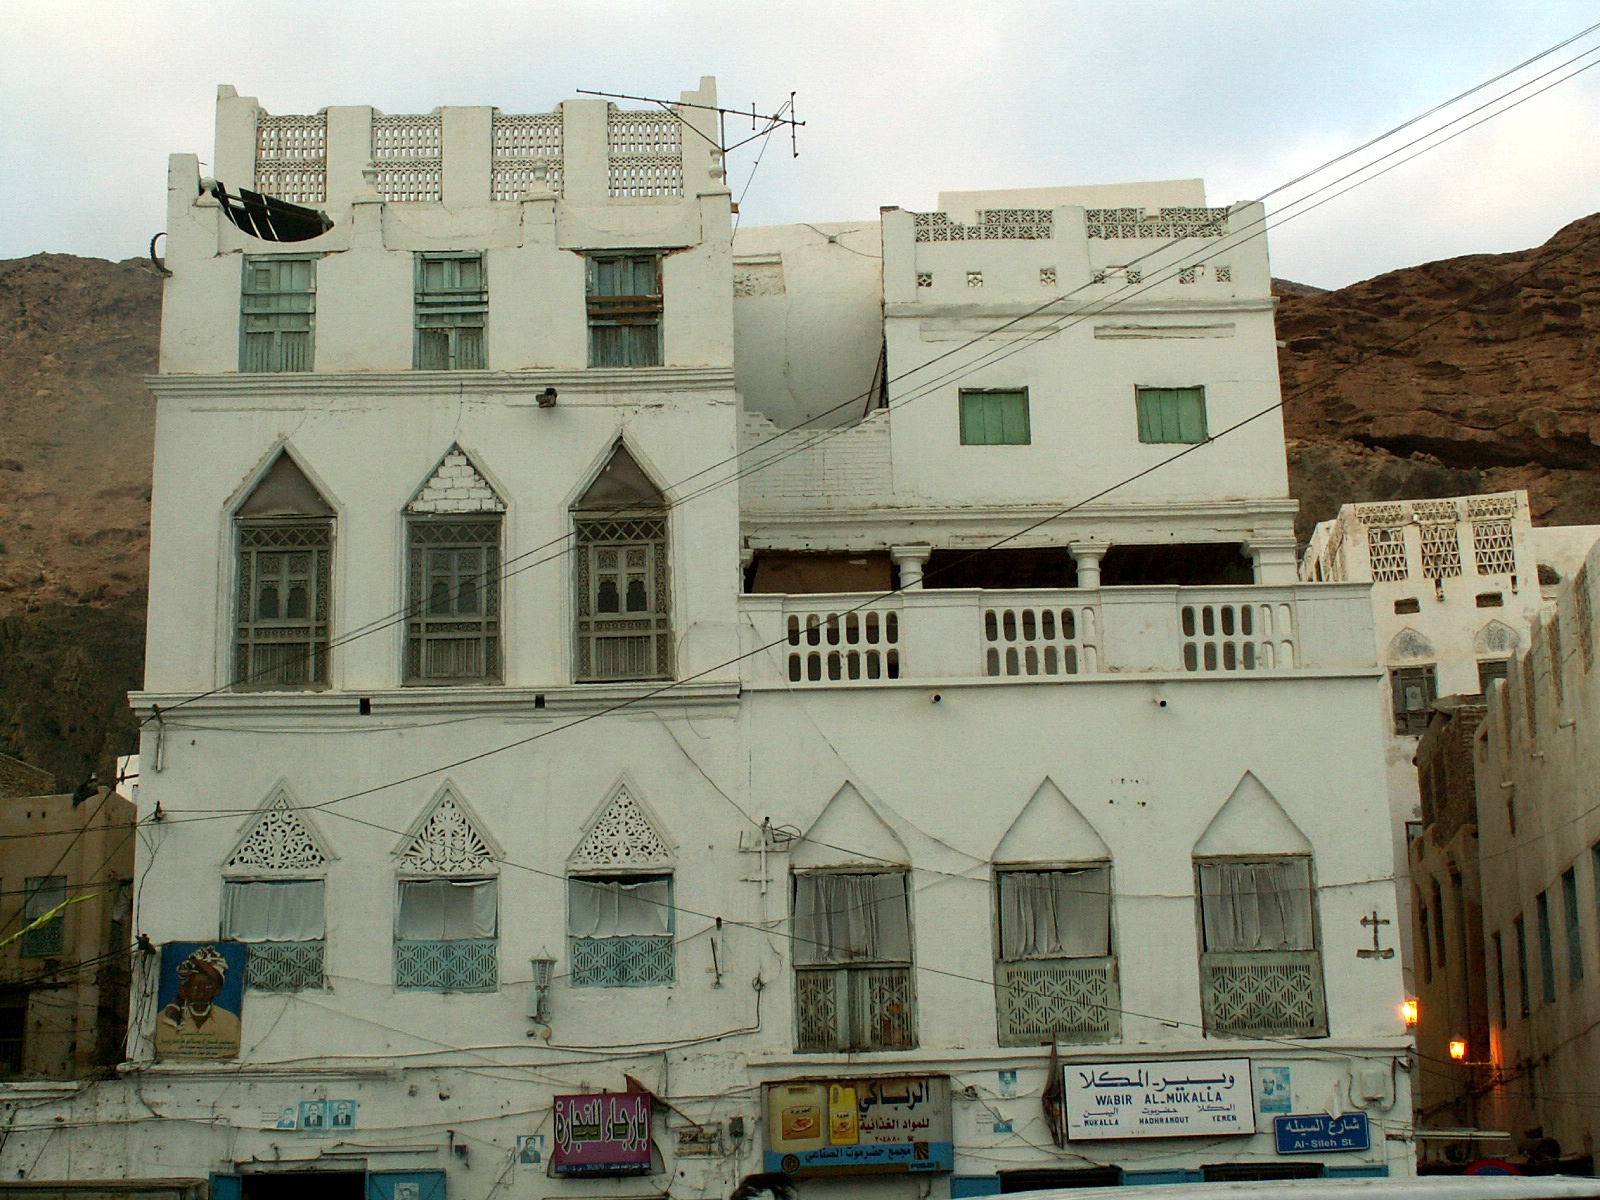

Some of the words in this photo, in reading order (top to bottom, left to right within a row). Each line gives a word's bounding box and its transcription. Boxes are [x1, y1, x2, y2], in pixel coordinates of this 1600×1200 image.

[1095, 1095, 1133, 1106] WABIR
[1083, 1106, 1119, 1118] اليمن
[1141, 1106, 1179, 1115] حضرموت
[1197, 1104, 1236, 1113] المكلا
[859, 1117, 899, 1134] الغذائية
[903, 1117, 930, 1132] للمواد
[1083, 1119, 1119, 1127] MUKALLA
[1139, 1116, 1190, 1125] HADHRAMOUT
[1212, 1114, 1238, 1123] YEMEN
[1328, 1118, 1360, 1136] شارع
[1294, 1139, 1338, 1149] Al-Sileh
[804, 1147, 843, 1163] الصناعي
[846, 1146, 885, 1160] حضرموت
[888, 1147, 911, 1160] مجمع
